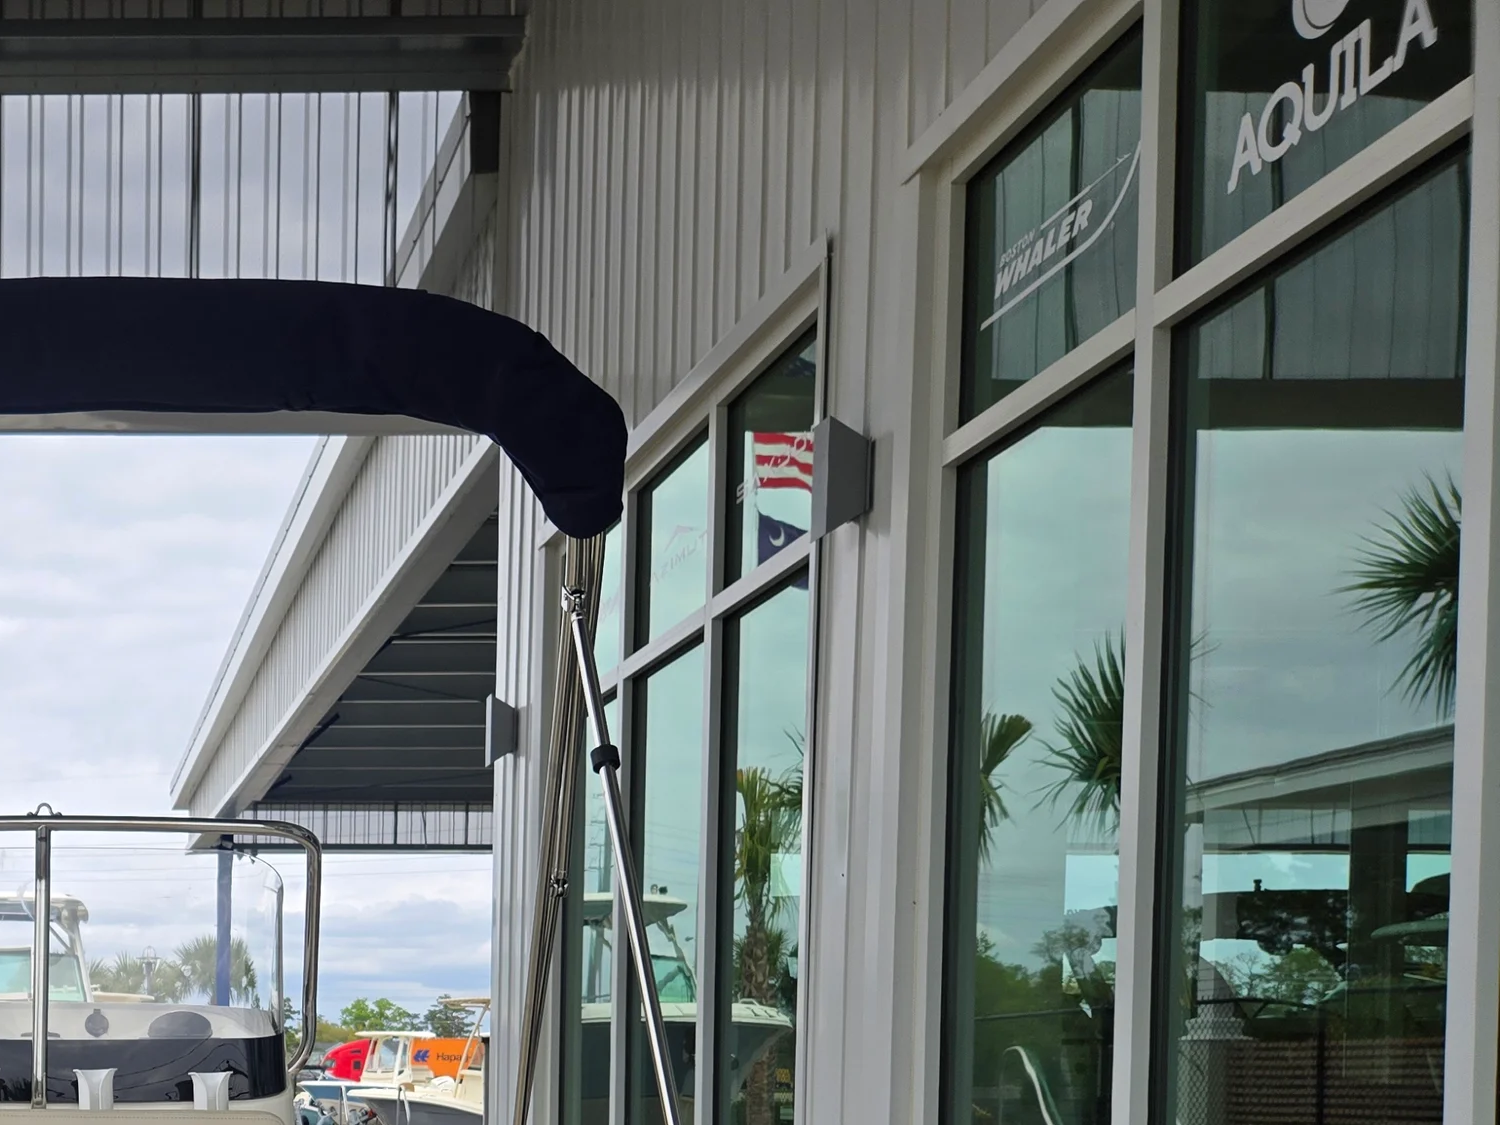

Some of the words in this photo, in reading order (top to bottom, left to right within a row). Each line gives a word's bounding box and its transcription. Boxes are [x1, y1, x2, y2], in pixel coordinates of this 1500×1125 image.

[1227, 0, 1438, 195] AQUILA
[994, 199, 1093, 300] WHALER
[999, 228, 1036, 269] BOSTON
